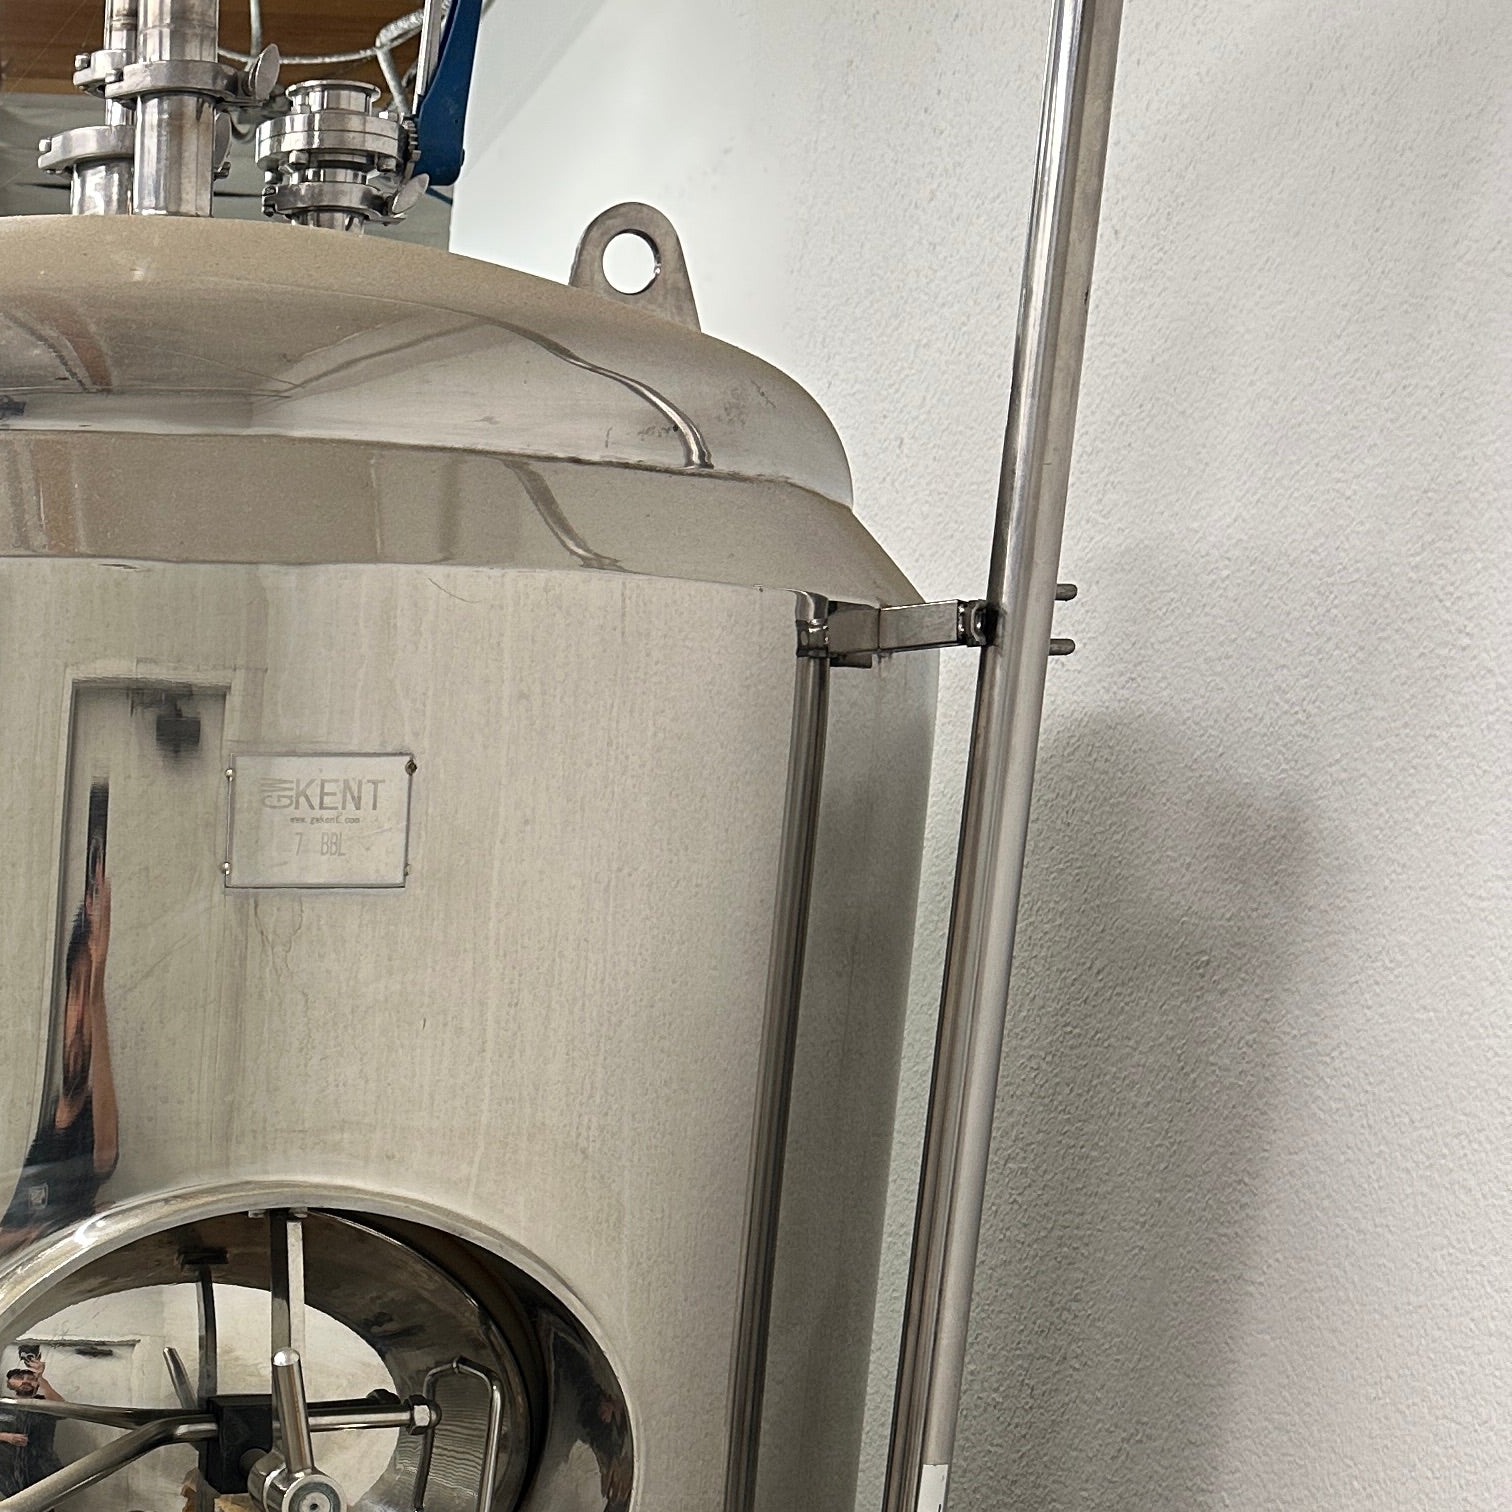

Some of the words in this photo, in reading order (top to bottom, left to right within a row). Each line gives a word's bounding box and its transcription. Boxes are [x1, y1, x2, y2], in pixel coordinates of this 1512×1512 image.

[294, 778, 386, 811] KENT
[295, 832, 304, 856] 7
[320, 831, 347, 857] BBL
